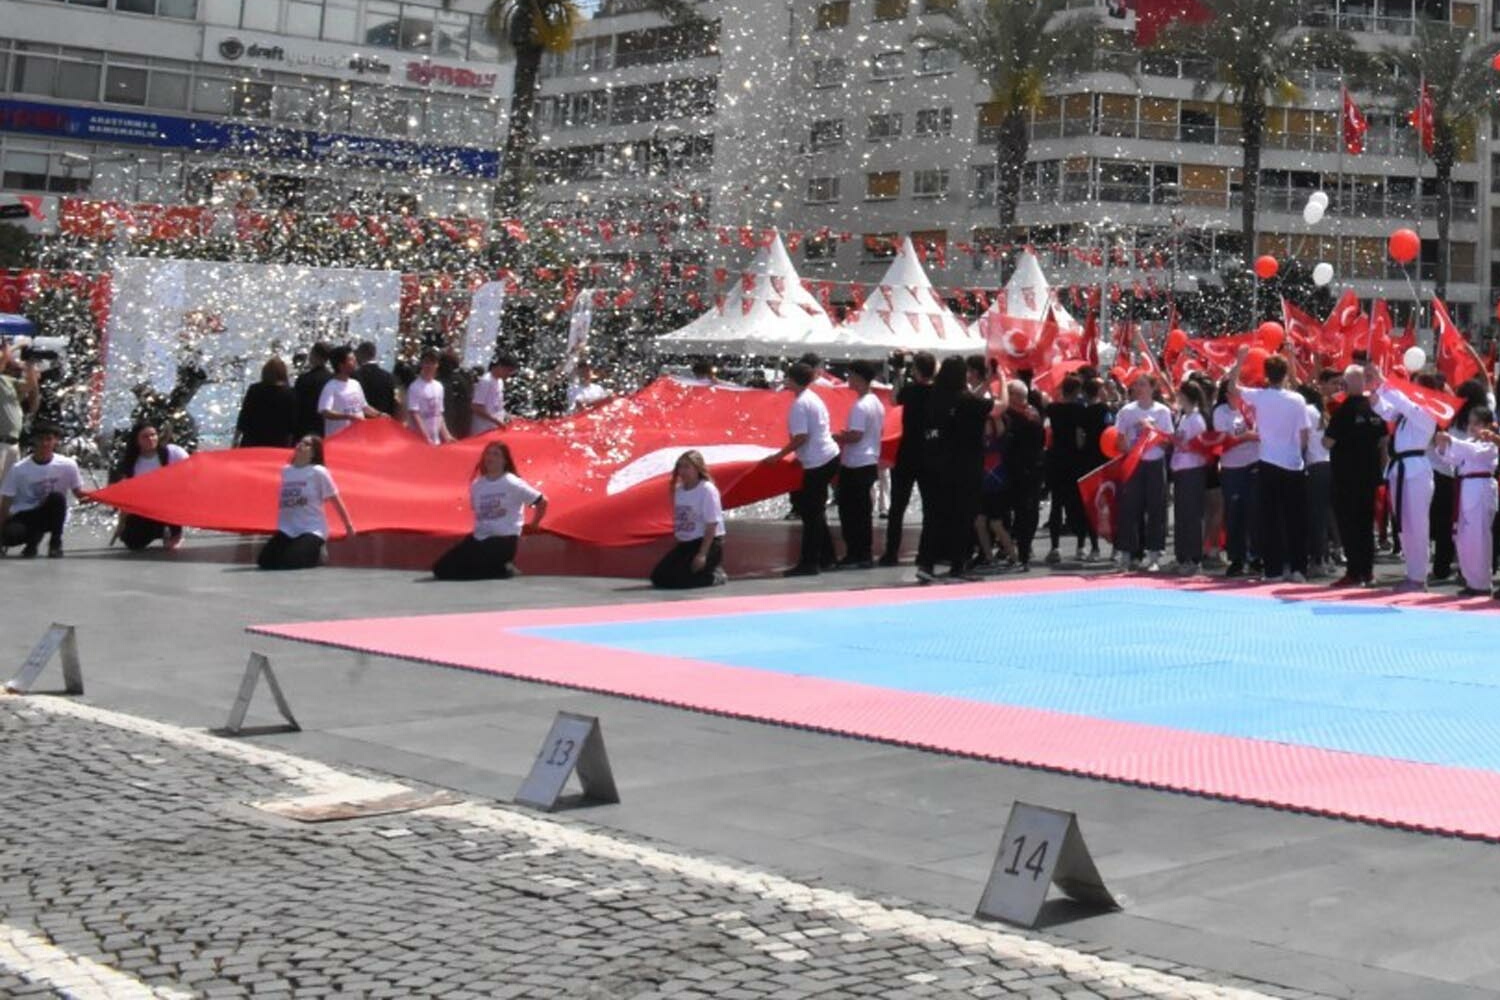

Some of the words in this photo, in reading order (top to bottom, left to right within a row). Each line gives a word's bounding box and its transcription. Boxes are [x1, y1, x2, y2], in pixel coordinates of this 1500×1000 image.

[247, 39, 284, 61] draft
[545, 738, 576, 766] 13
[1004, 835, 1049, 881] 14
